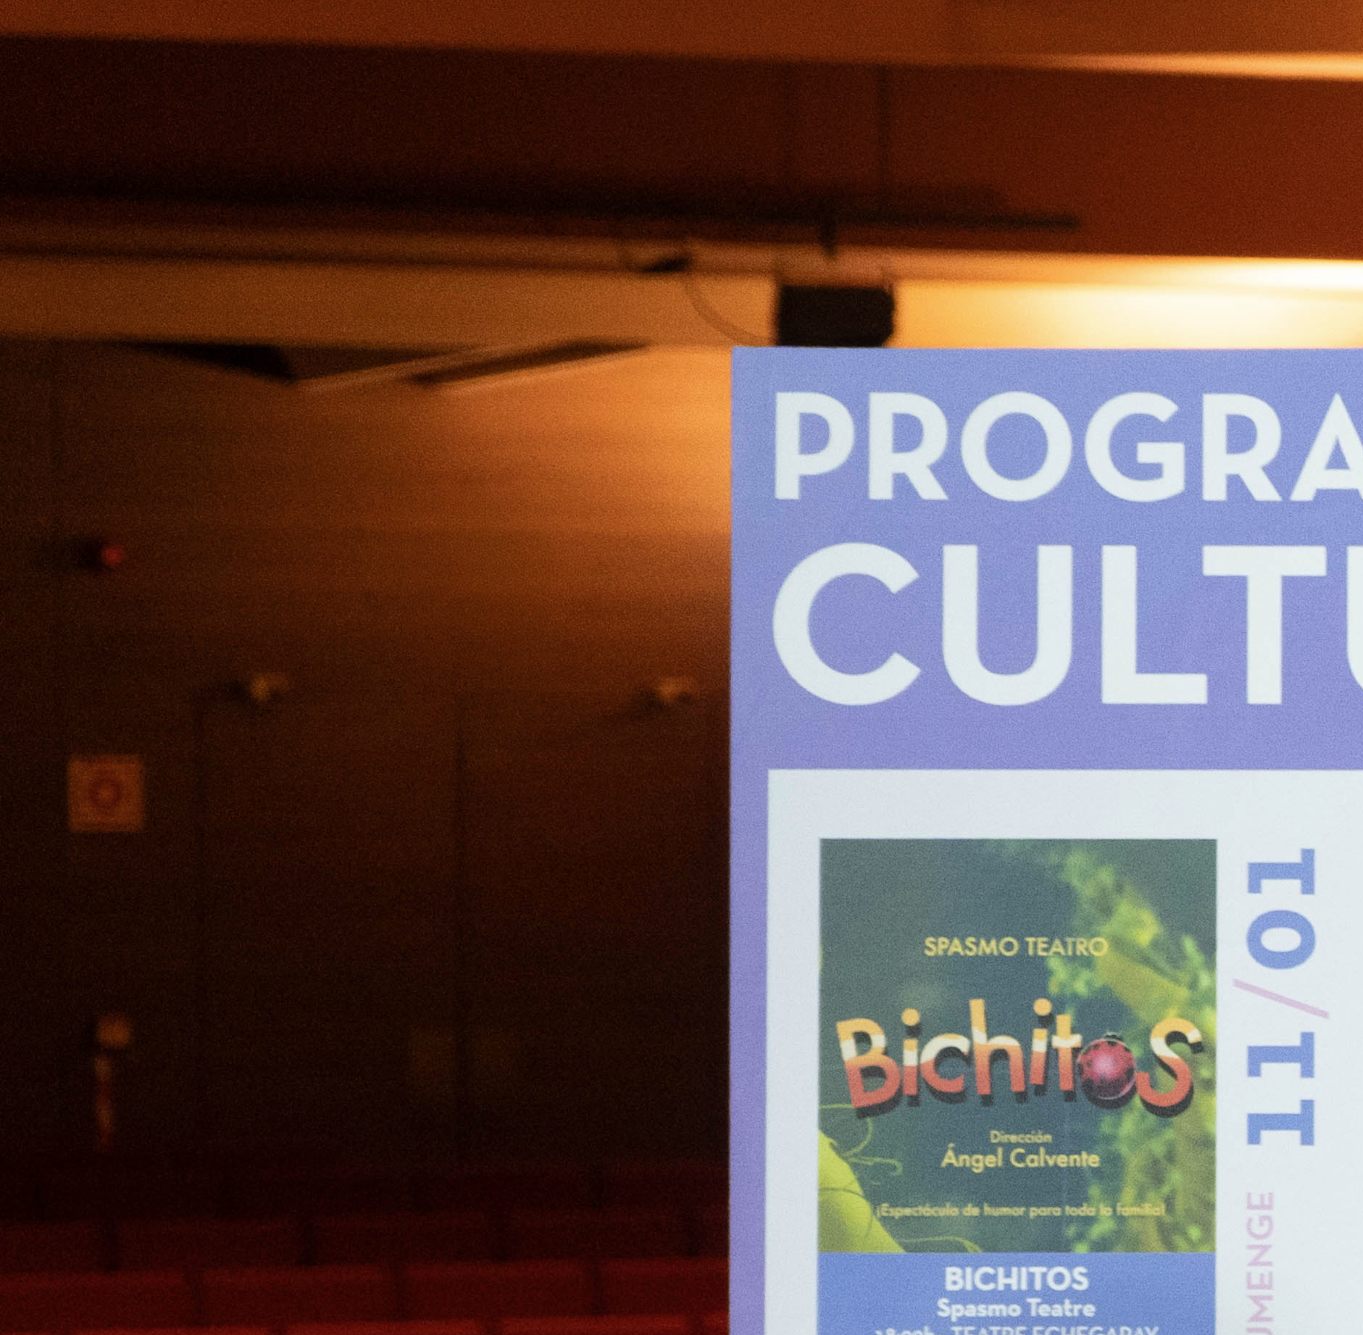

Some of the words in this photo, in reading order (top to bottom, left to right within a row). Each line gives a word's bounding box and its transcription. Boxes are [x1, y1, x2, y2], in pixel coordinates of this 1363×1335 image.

[923, 936, 1019, 957] SPASMO
[1025, 936, 1109, 957] TEATRO
[1232, 848, 1330, 1147] 11/01
[989, 1129, 1053, 1144] Dirección
[940, 1140, 1004, 1175] Ángel
[1009, 1140, 1102, 1169] Calvente
[944, 1265, 1090, 1292] BICHITOS
[936, 1296, 1023, 1323] Spasmo
[1025, 1296, 1097, 1318] Teatre
